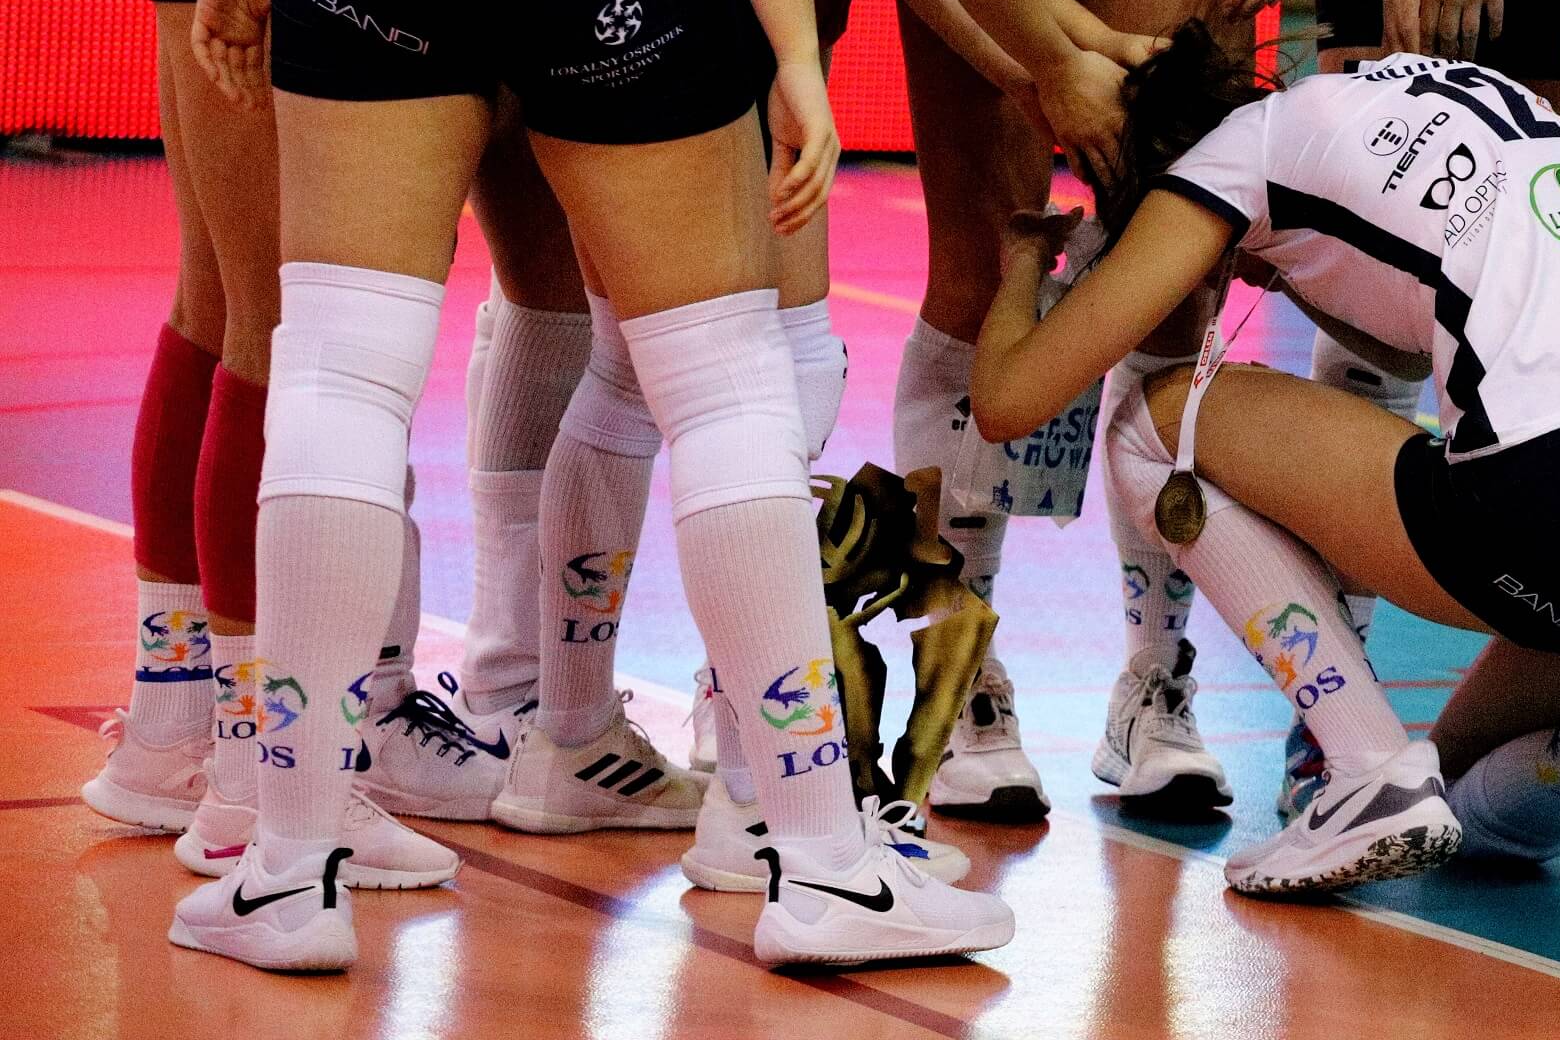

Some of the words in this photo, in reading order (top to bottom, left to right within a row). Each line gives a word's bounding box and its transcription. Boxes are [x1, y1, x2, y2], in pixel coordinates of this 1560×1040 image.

[1381, 111, 1450, 194] TIENTO
[1444, 216, 1467, 248] AD
[561, 618, 620, 643] LO
[1295, 665, 1346, 710] OS
[216, 719, 257, 740] LO
